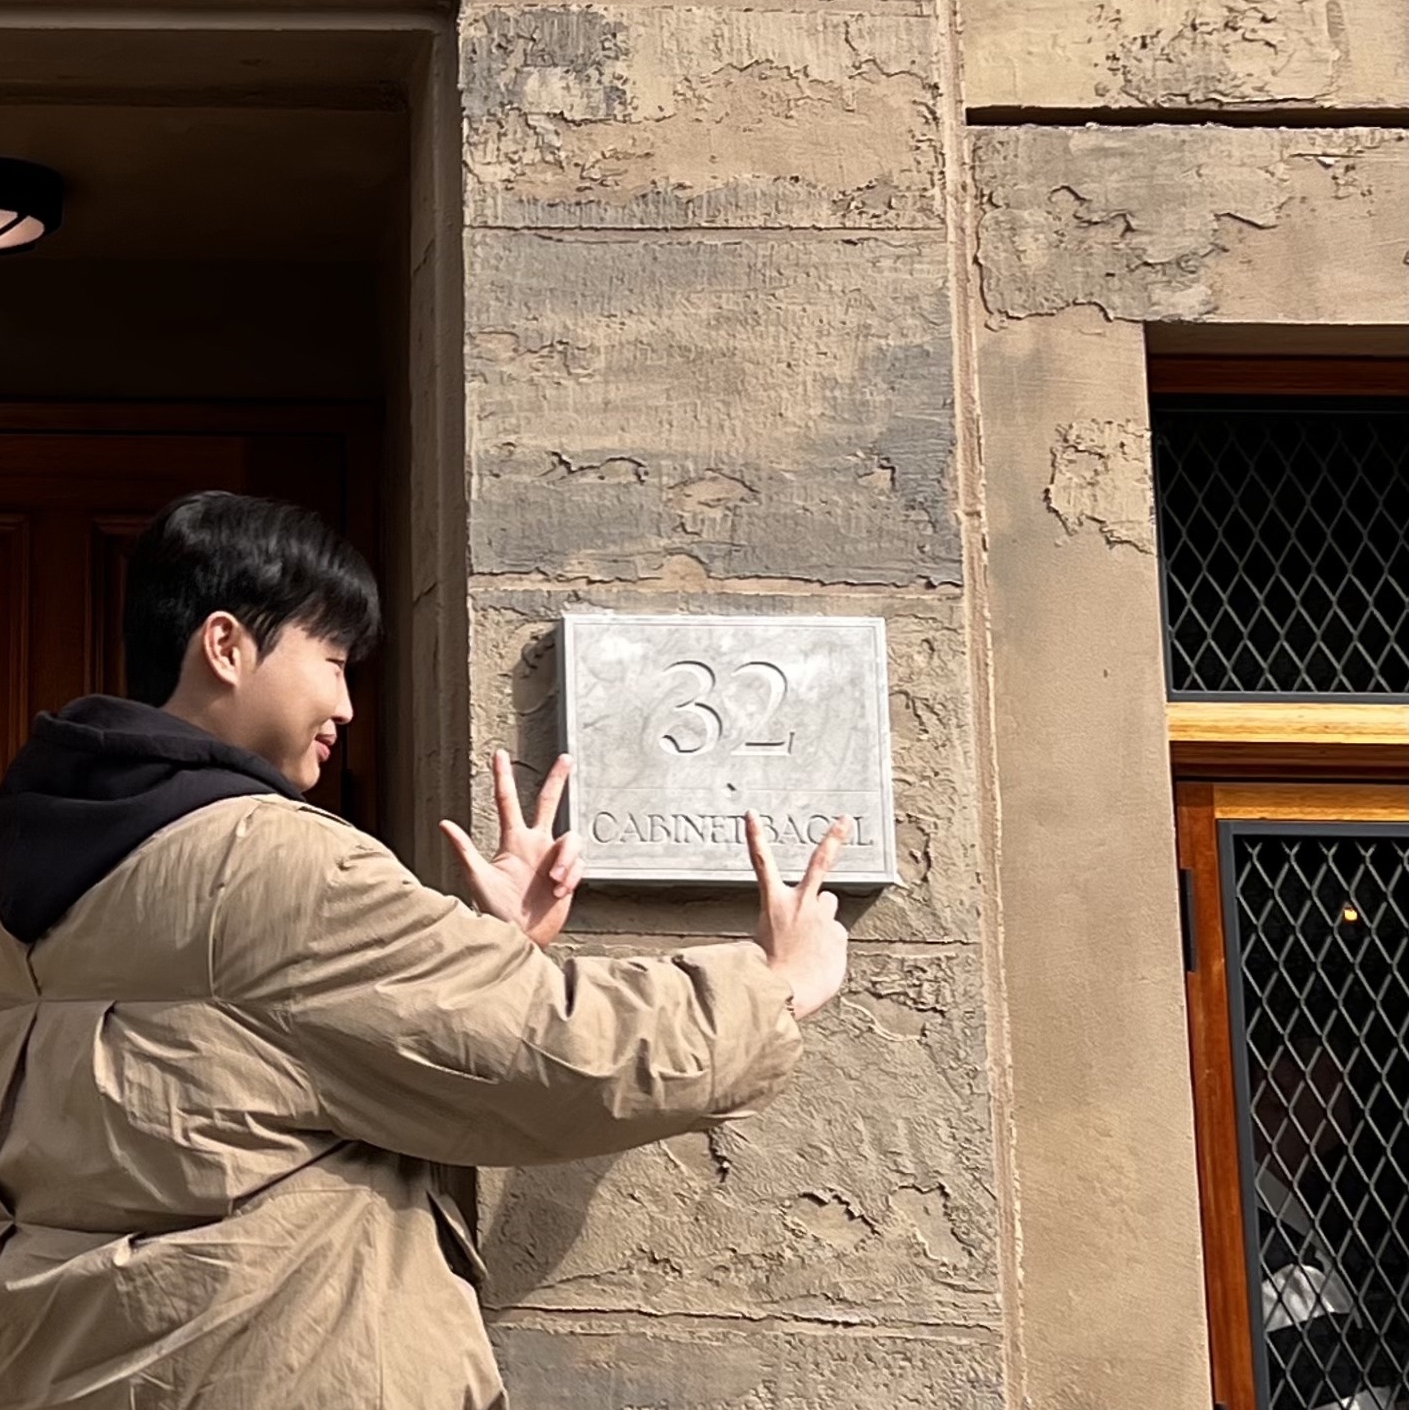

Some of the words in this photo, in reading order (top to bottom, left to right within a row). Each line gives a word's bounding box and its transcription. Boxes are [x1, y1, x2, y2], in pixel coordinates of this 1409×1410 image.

[658, 659, 796, 756] 32
[591, 810, 748, 846] CABINET
[756, 812, 874, 847] BAGL
